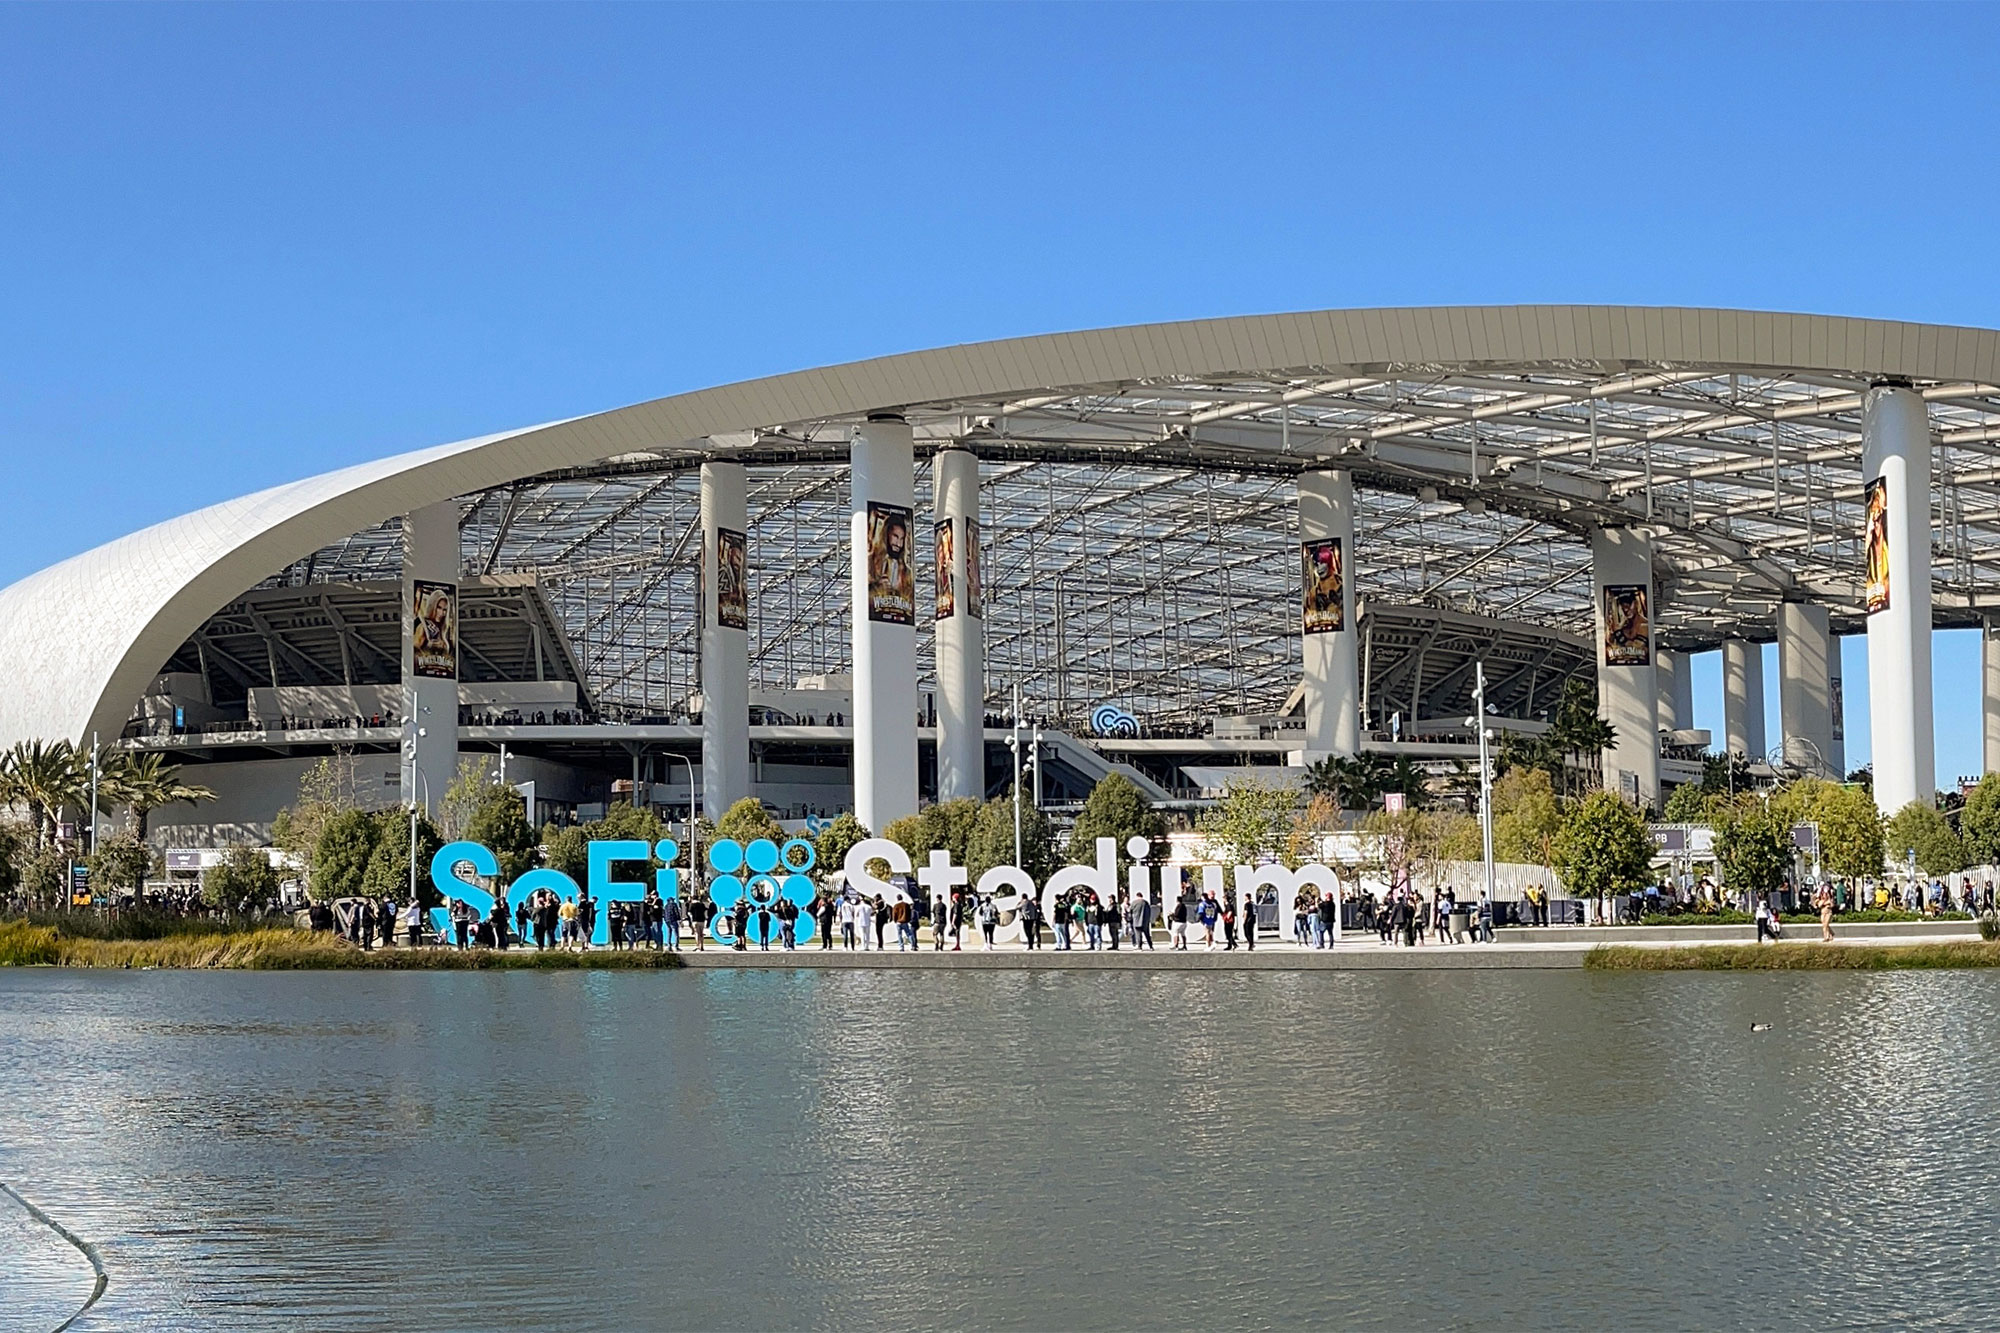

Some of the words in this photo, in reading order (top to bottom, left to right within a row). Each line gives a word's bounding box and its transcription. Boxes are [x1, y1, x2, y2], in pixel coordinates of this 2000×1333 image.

[1391, 797, 1399, 810] 9
[430, 838, 680, 946] SoFi
[843, 835, 1341, 944] Stadium
